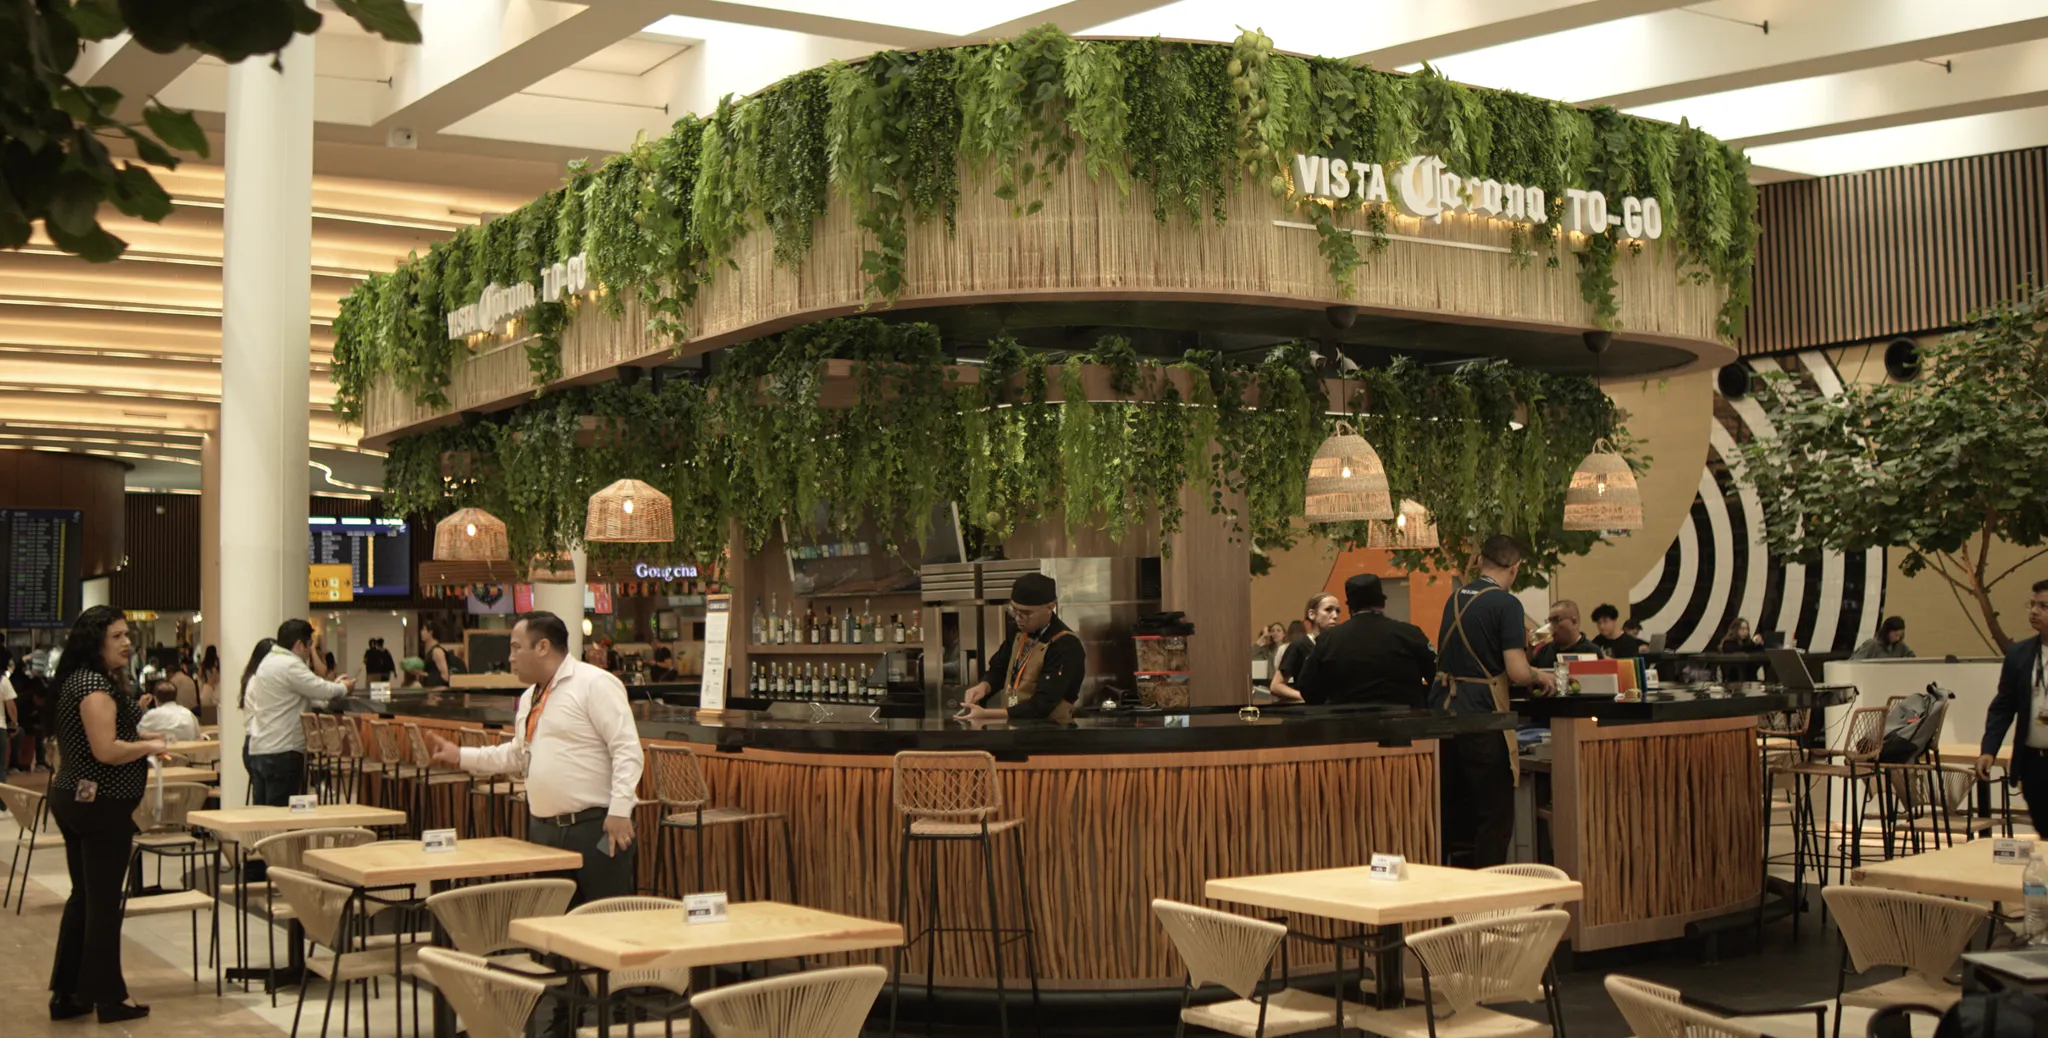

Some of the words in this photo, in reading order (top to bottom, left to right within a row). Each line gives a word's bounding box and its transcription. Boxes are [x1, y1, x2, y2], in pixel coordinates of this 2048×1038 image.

[1296, 154, 1389, 202] VISTA
[1401, 155, 1548, 224] Corona
[1566, 188, 1662, 239] TO-GO
